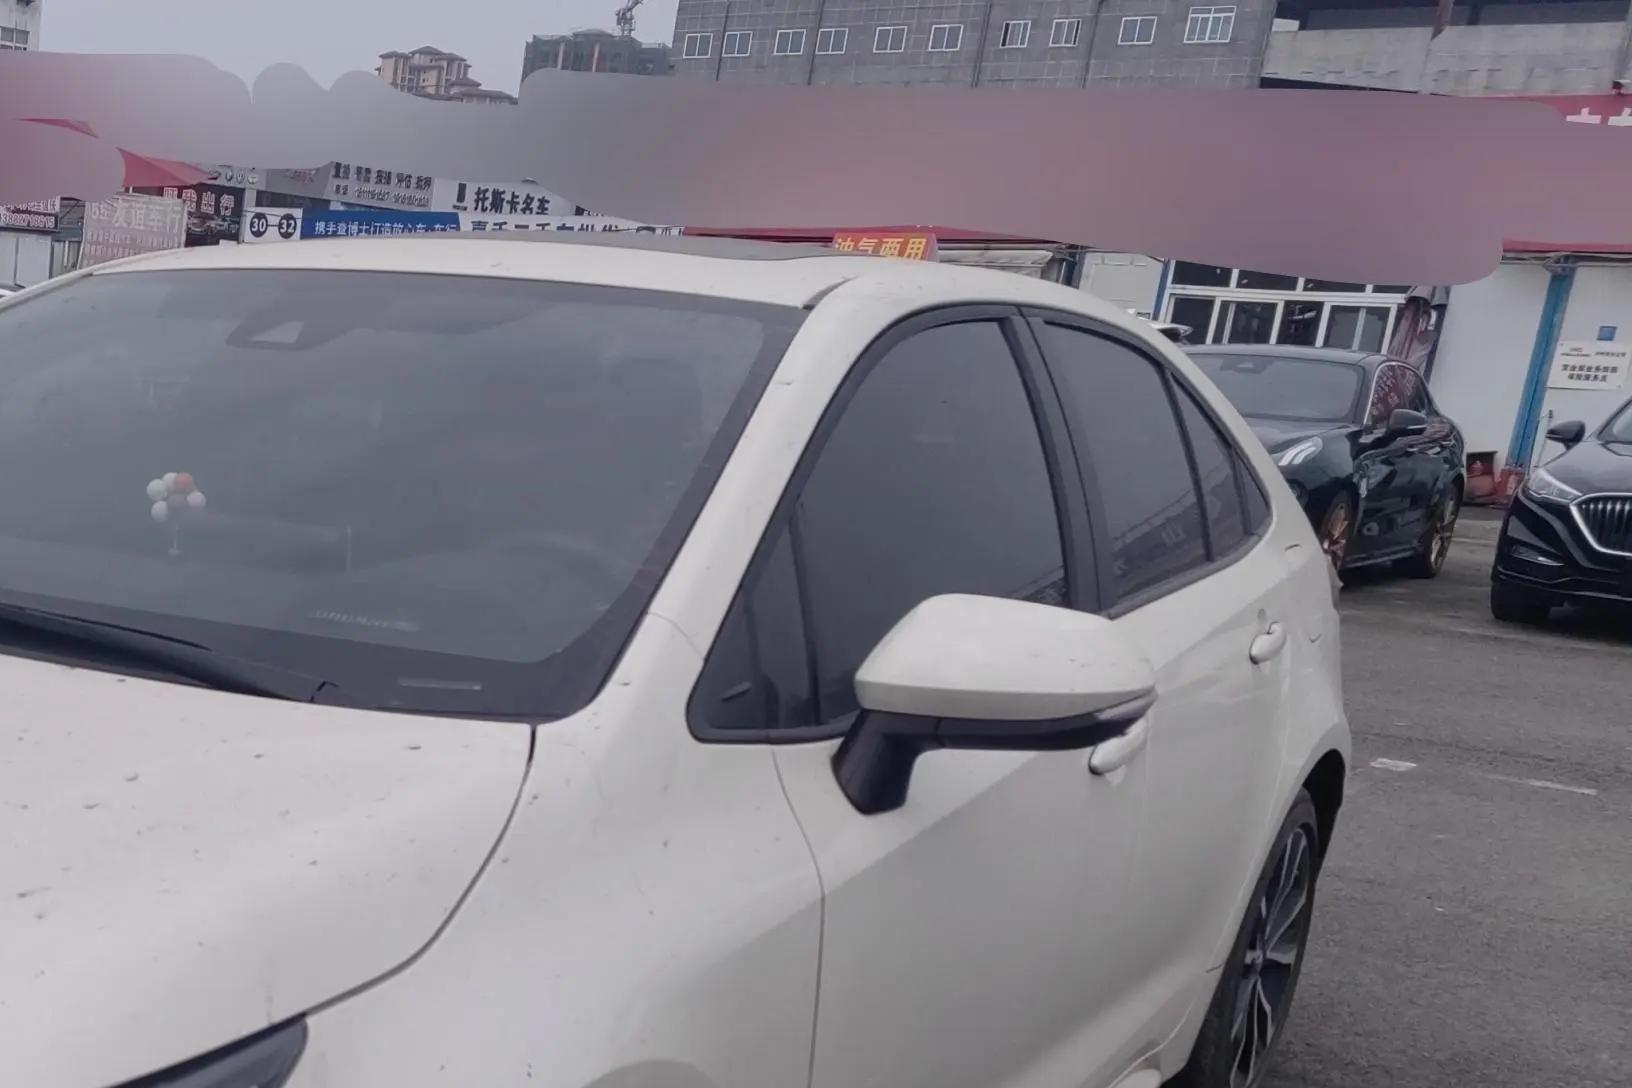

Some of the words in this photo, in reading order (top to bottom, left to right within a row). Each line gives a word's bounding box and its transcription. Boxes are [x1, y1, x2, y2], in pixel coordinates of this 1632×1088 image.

[473, 187, 550, 215] 托斯卡名车
[251, 218, 267, 231] 30
[280, 219, 295, 232] 32
[835, 237, 927, 260] 油气两用
